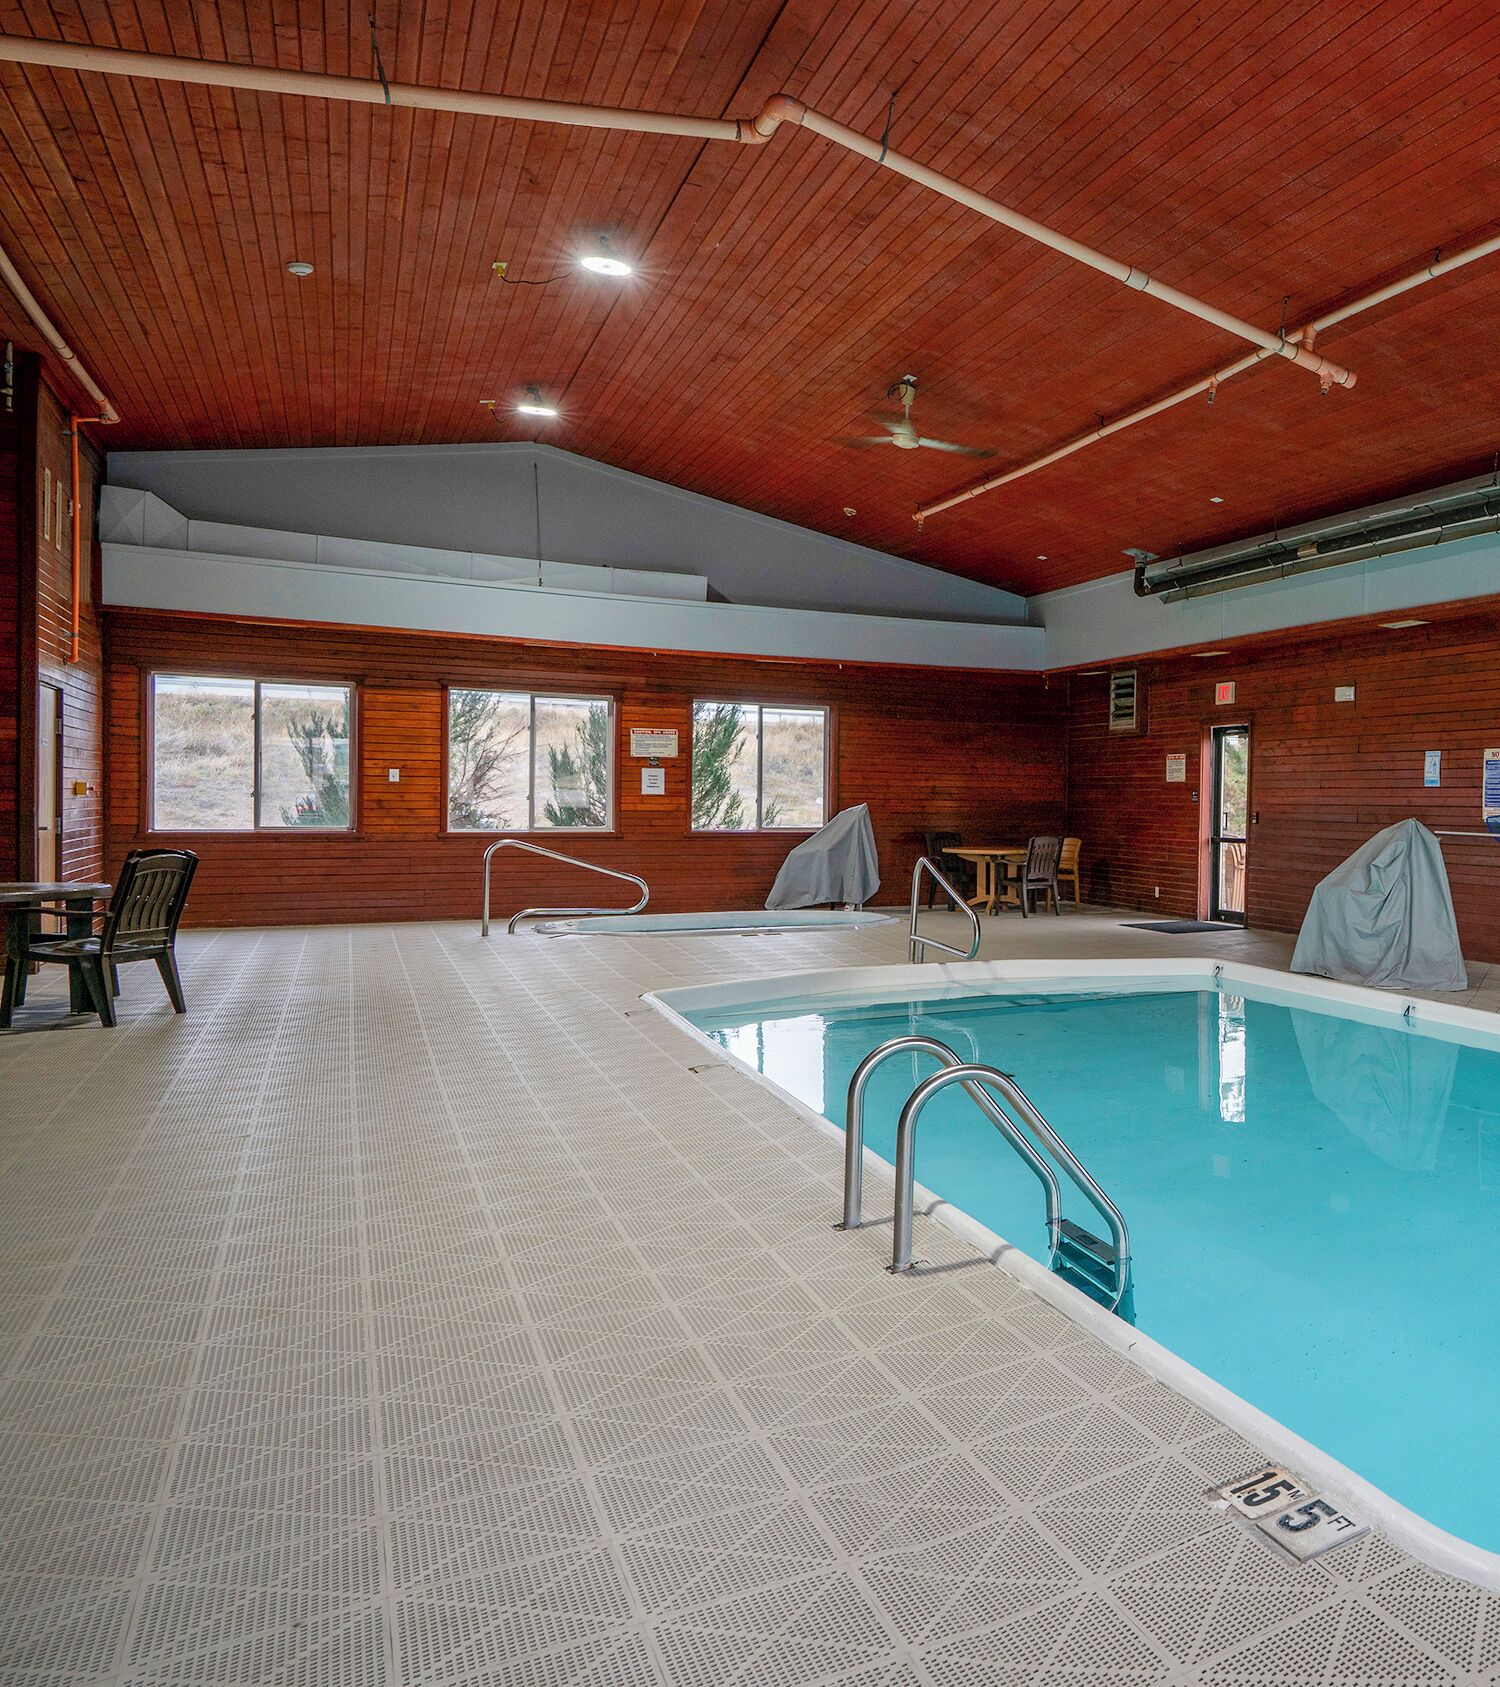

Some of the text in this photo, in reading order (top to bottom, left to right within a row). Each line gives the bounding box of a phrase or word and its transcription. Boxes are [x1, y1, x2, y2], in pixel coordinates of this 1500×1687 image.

[1287, 1489, 1305, 1501] M
[1276, 1498, 1356, 1532] 5 FT
